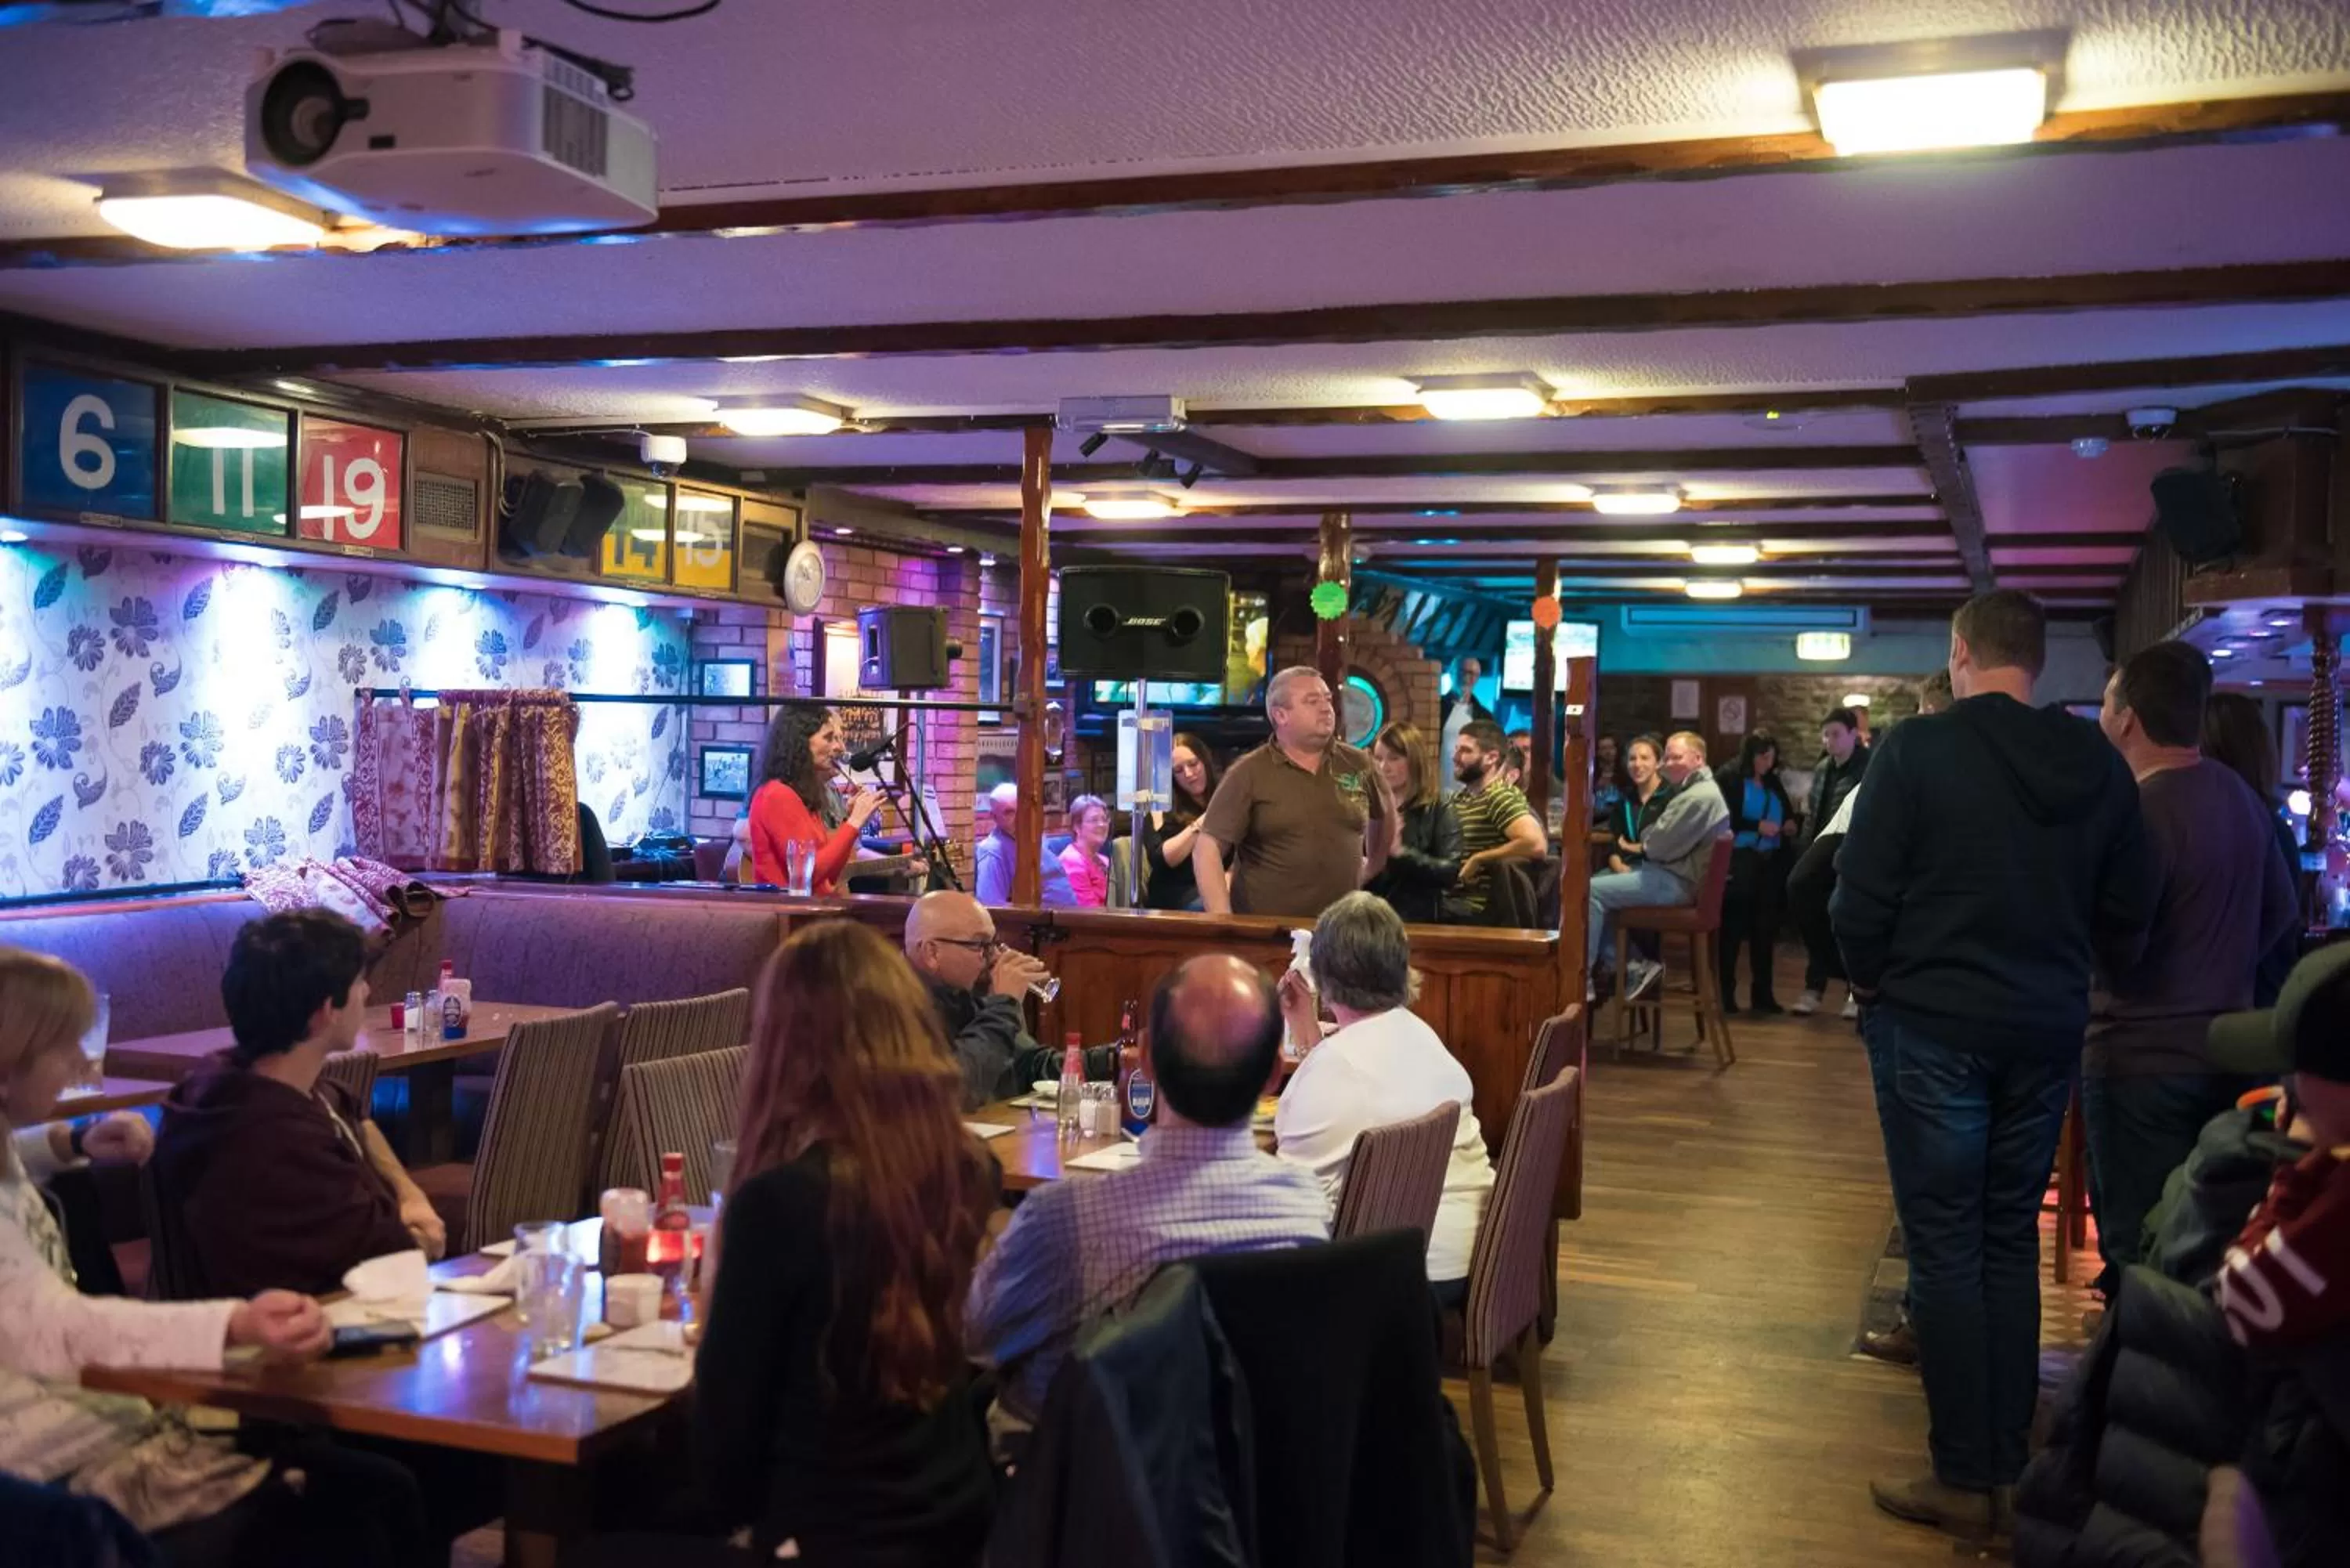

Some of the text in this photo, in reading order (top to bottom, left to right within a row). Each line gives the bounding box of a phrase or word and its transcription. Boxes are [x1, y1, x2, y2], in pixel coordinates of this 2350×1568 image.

[59, 394, 116, 490] 6
[212, 440, 255, 518] 11
[323, 454, 386, 541] 19
[615, 513, 656, 568] 14
[686, 510, 723, 569] 15
[1122, 616, 1166, 626] BOSE
